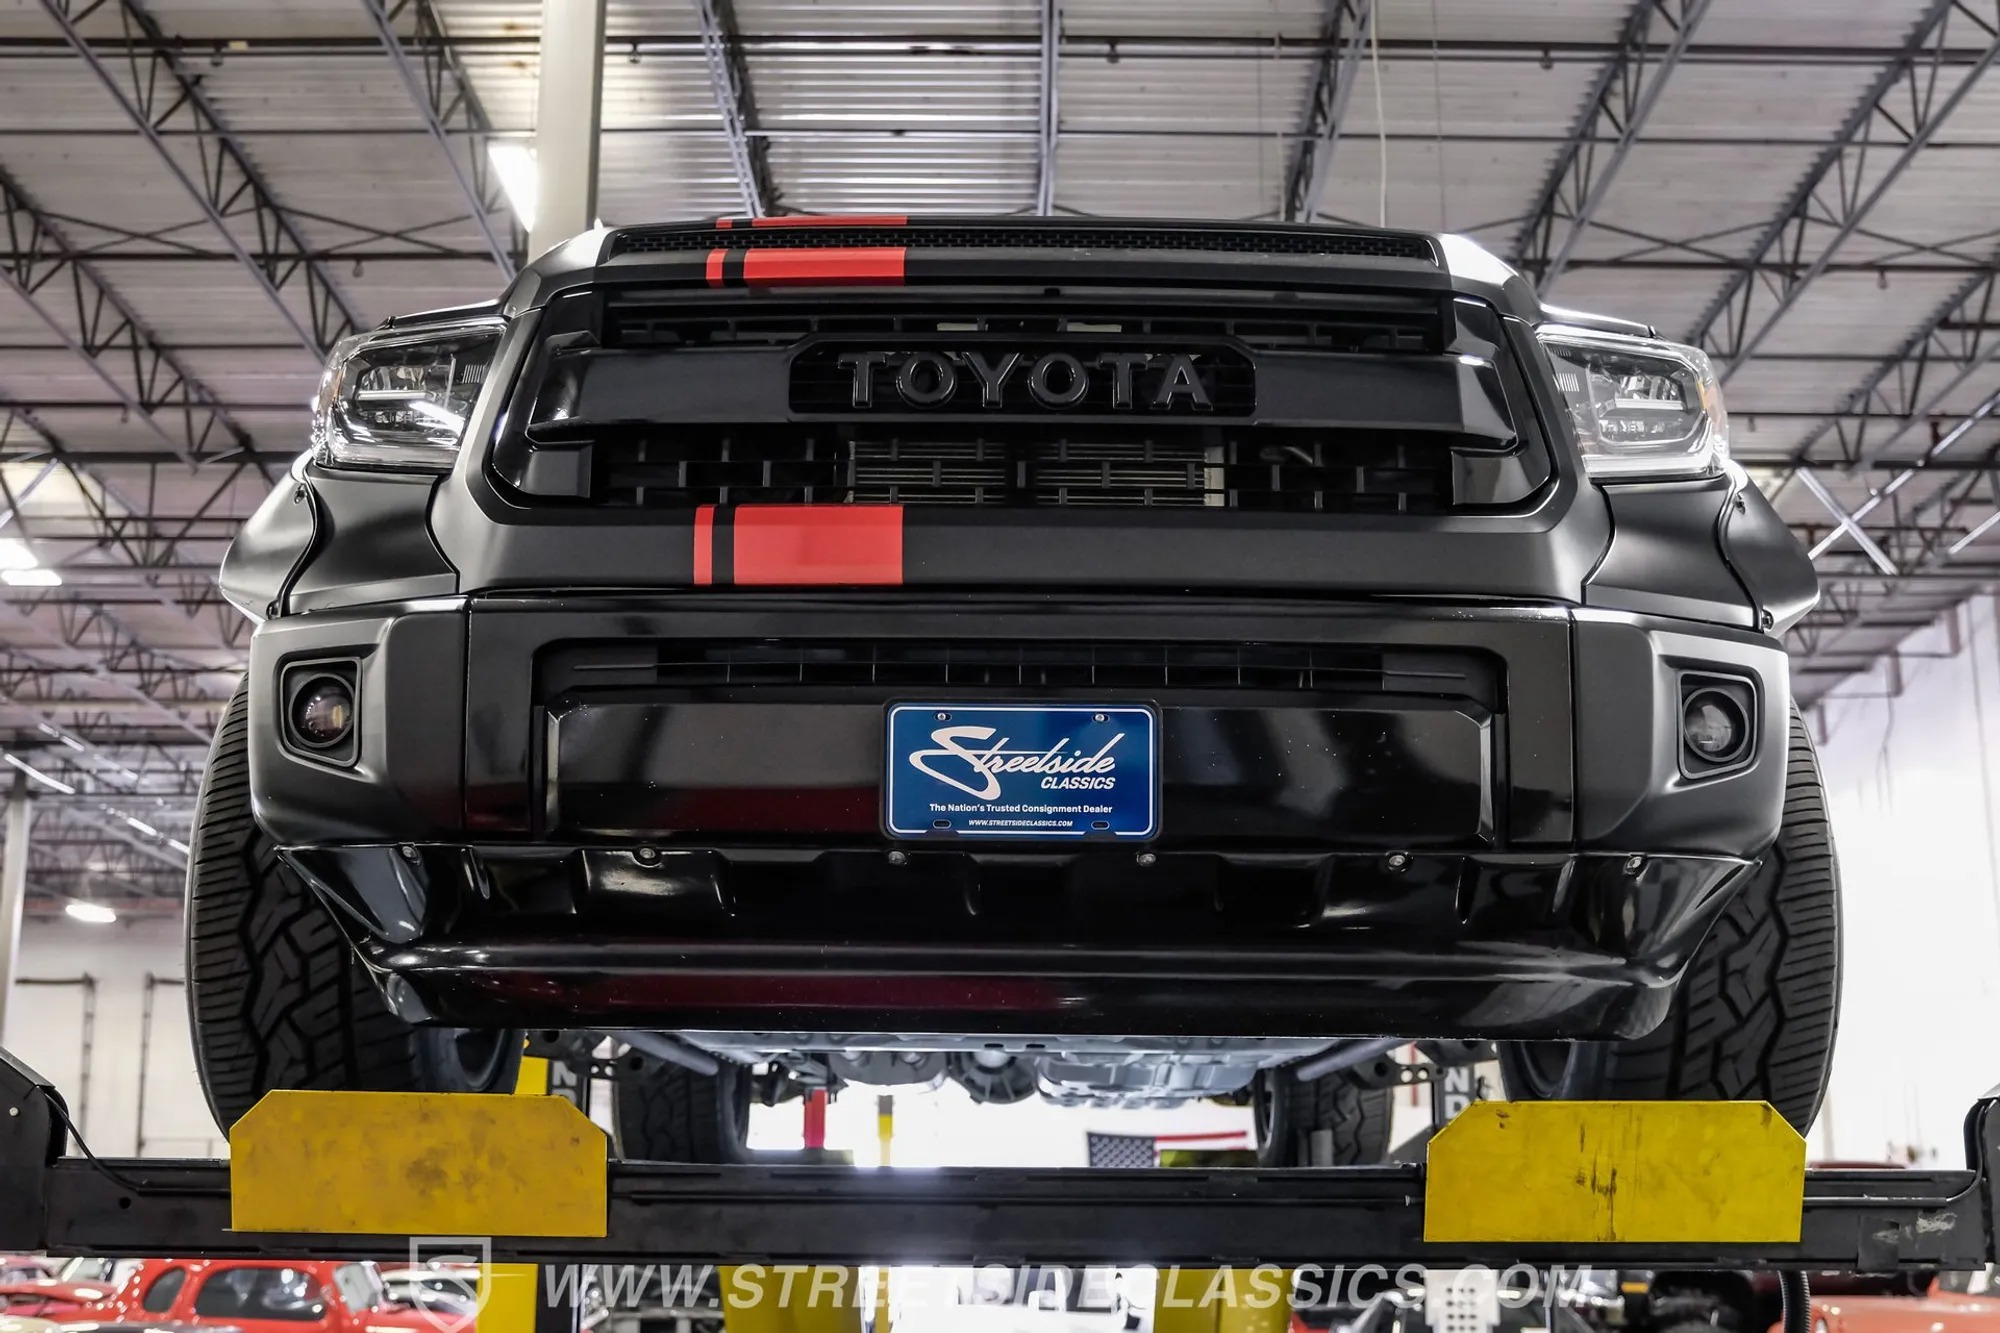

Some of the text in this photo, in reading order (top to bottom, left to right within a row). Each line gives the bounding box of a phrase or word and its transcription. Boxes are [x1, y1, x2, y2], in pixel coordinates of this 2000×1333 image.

[837, 351, 1214, 411] TOYOTA
[908, 725, 1126, 801] Streetside
[1040, 776, 1116, 790] CLASSICS
[929, 803, 1113, 815] The Nation's Trusted Consignment Dealer
[968, 818, 1074, 828] WWW.STREETSIDECLASSICS.COM
